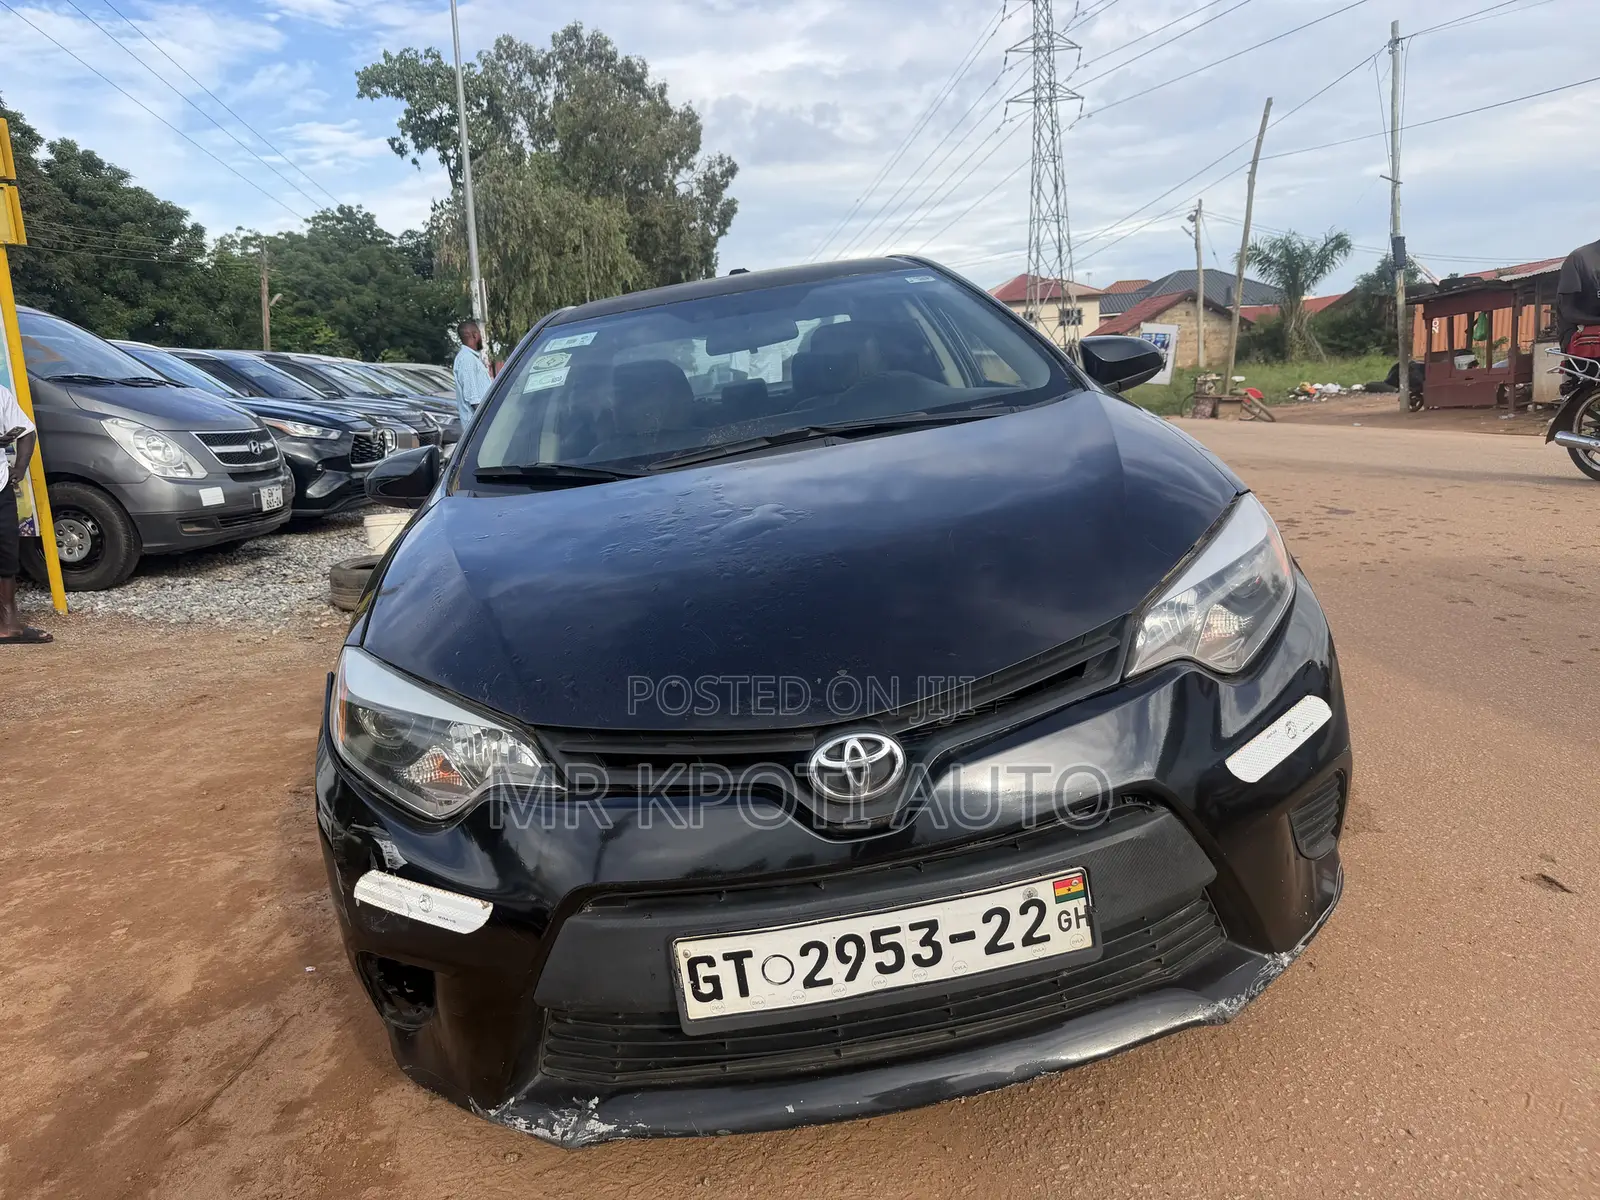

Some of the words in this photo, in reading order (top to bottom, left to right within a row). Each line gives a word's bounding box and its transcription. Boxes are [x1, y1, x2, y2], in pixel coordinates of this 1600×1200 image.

[688, 950, 753, 1003] GT
[799, 898, 1052, 990] 2953-22
[1057, 905, 1092, 932] GH
